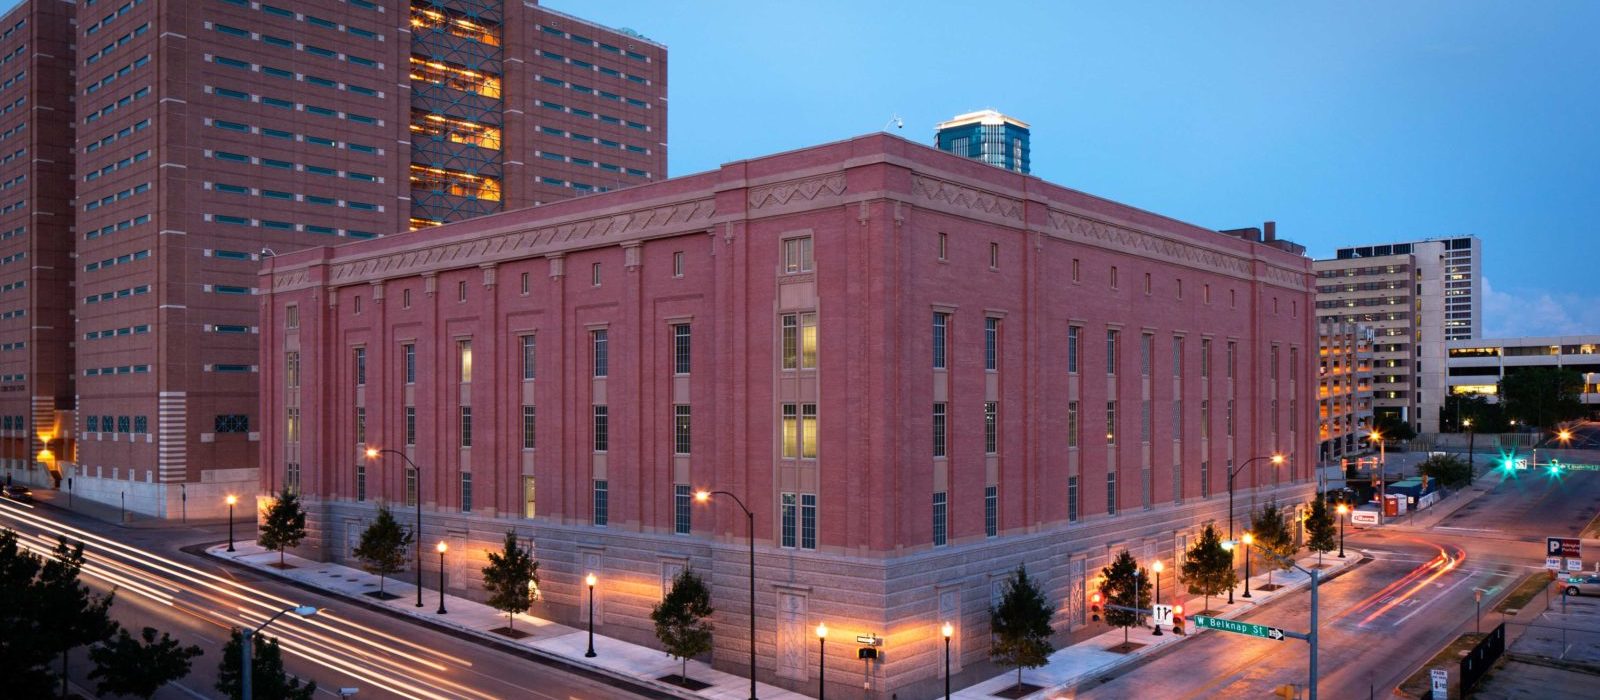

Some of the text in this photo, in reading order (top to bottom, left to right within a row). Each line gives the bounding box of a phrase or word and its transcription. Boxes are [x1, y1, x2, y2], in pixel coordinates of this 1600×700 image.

[1550, 541, 1560, 552] P
[1198, 616, 1204, 624] W
[1210, 618, 1247, 632] Belknap
[1253, 625, 1263, 634] St
